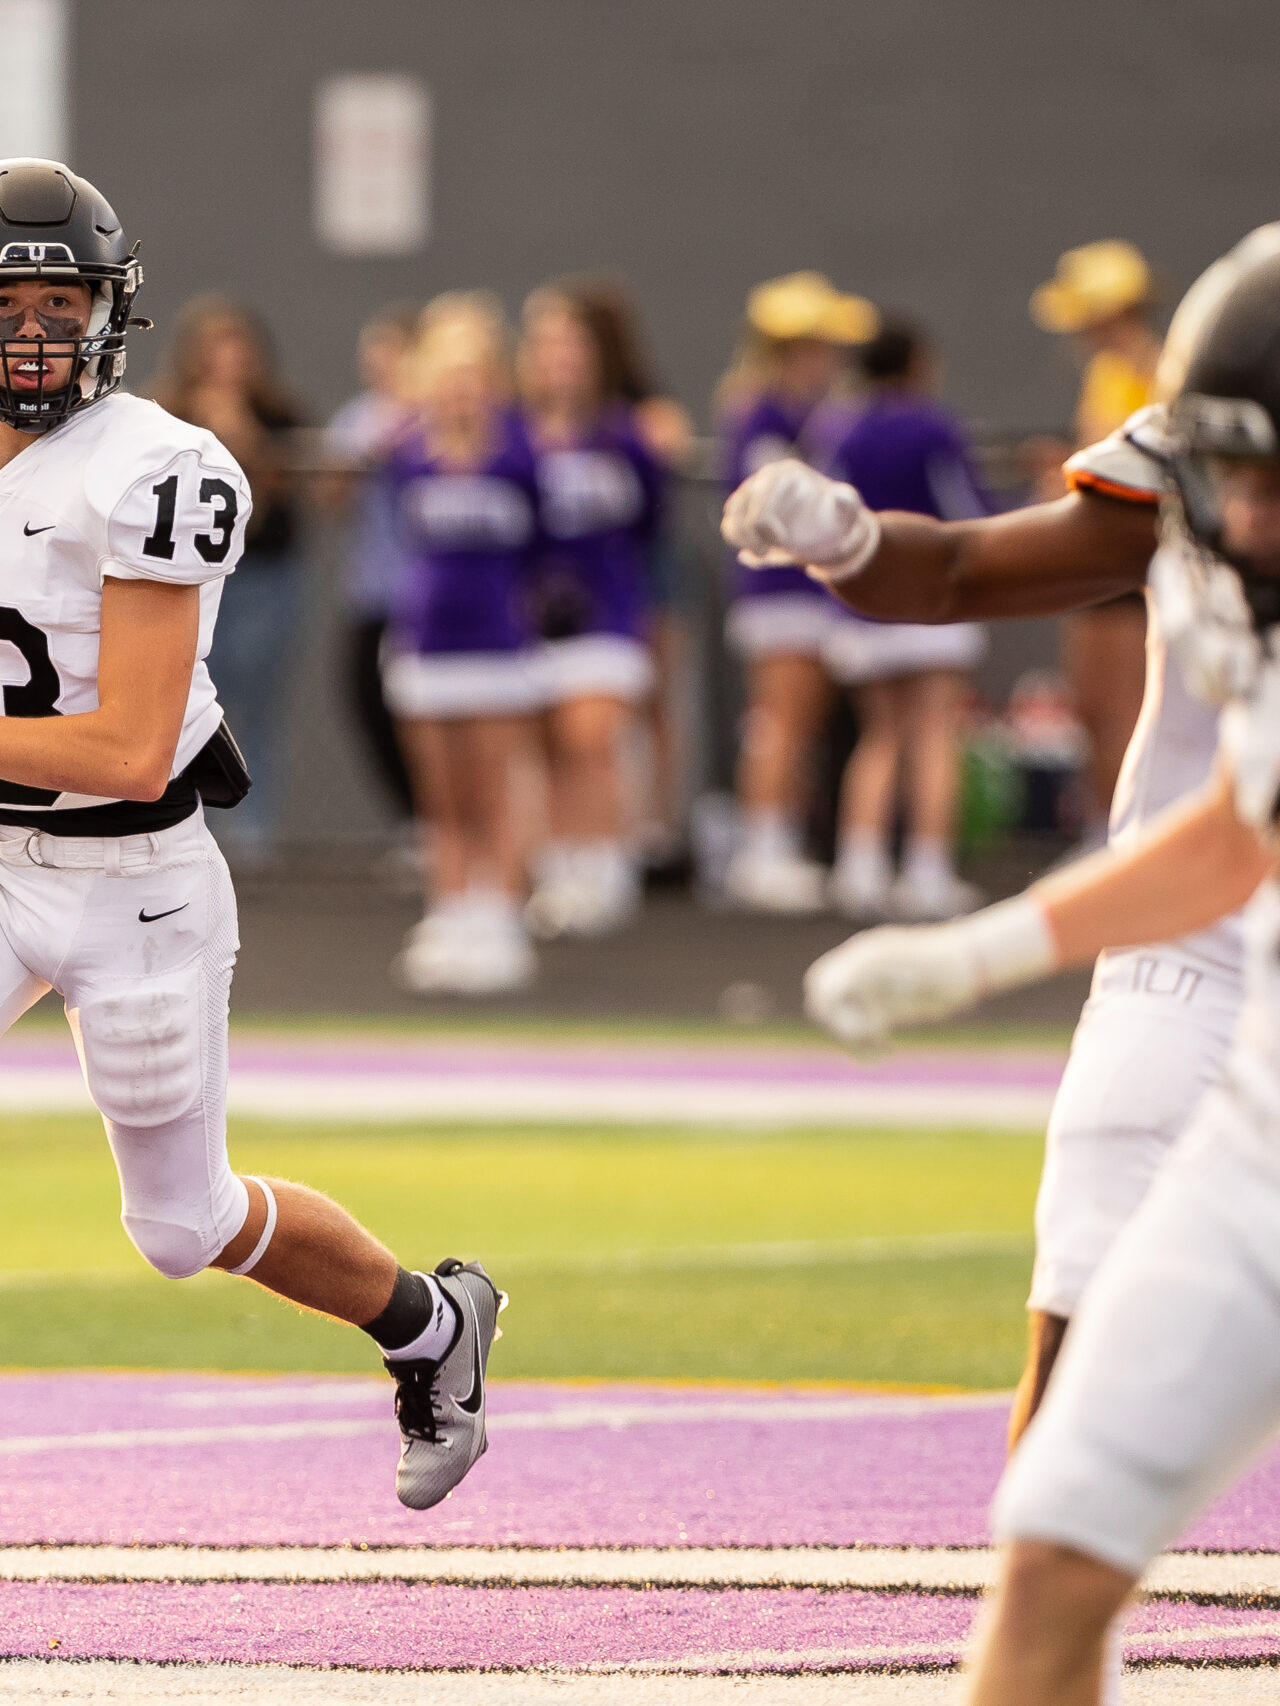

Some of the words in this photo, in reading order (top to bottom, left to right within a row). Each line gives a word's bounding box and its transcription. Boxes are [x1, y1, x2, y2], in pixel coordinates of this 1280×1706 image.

[28, 245, 47, 261] U
[19, 402, 50, 412] Ridll
[142, 475, 238, 564] 13
